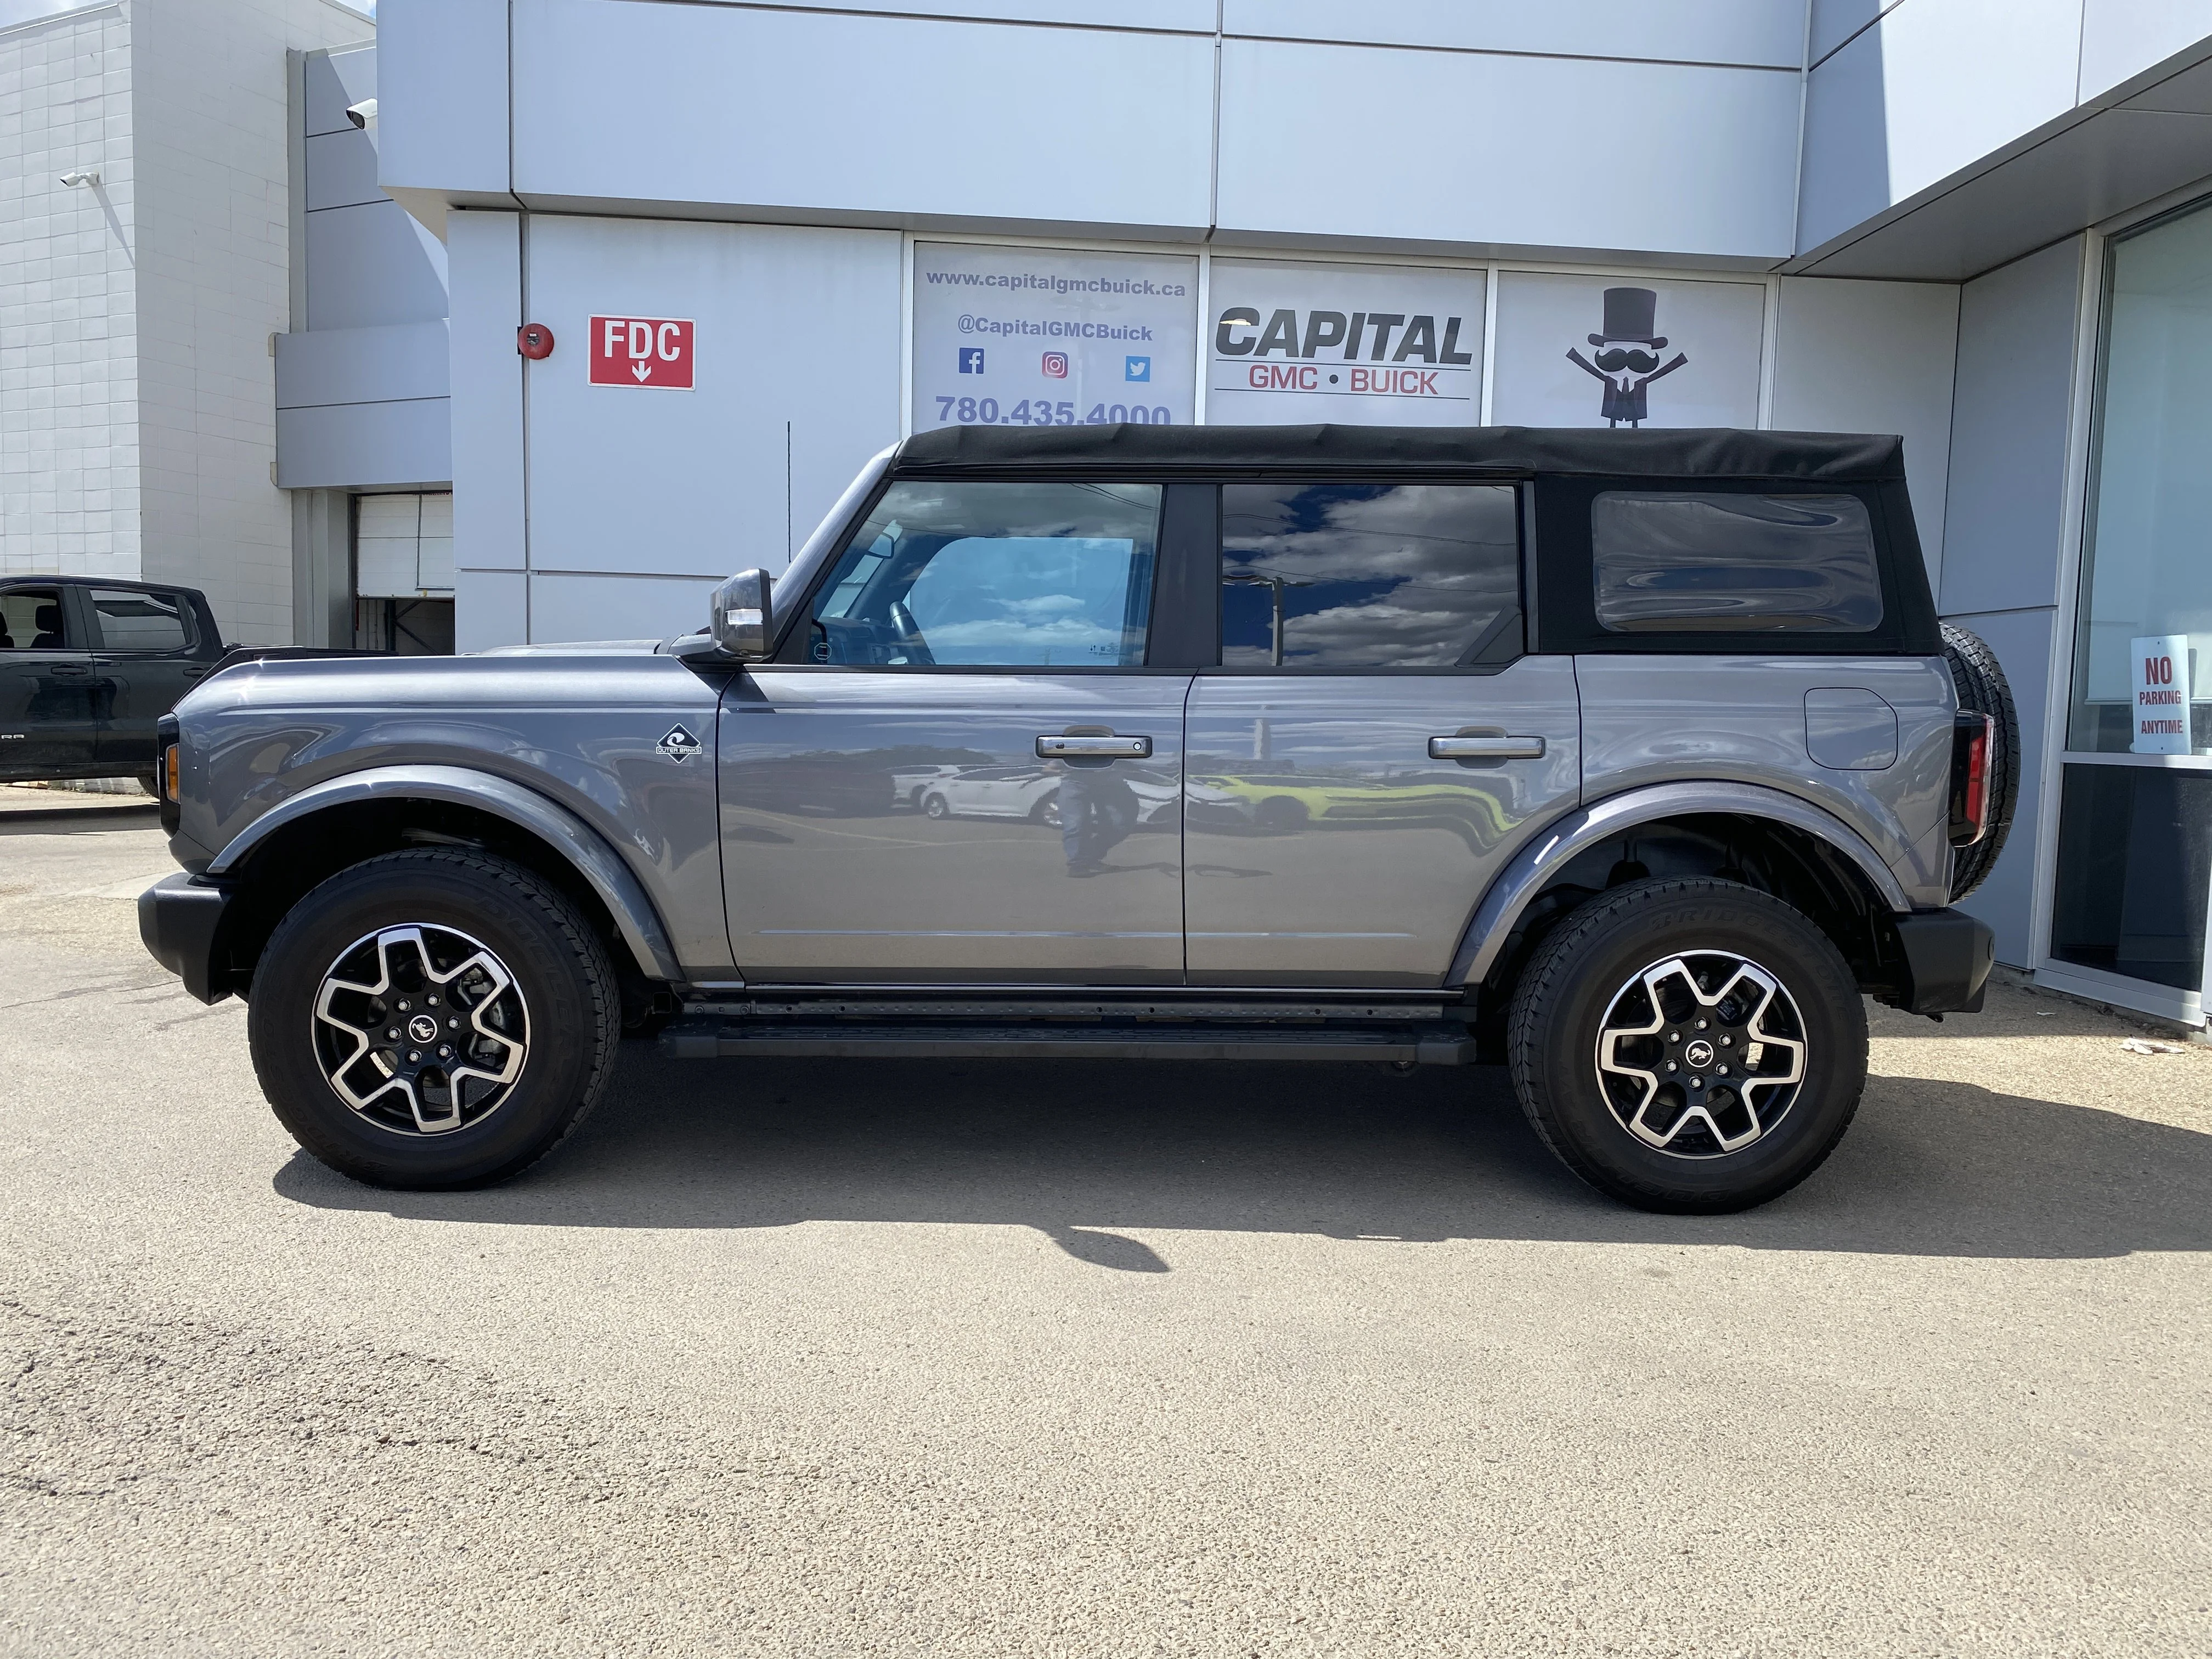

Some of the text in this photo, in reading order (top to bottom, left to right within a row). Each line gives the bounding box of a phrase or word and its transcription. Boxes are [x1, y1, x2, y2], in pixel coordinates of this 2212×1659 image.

[926, 272, 1186, 296] www.capitalgmcbuick.ca
[604, 320, 681, 362] FDC
[958, 314, 1153, 341] @CapitalGMCBuick
[1215, 306, 1473, 365] CAPITAL
[1248, 364, 1439, 396] GMC BUICK
[935, 396, 1171, 425] 780.435.4000
[2145, 656, 2172, 685] NO
[2140, 690, 2182, 706] PARKING
[2141, 720, 2183, 733] ANYTIME
[1649, 906, 1848, 1022] BRIDGESTONE
